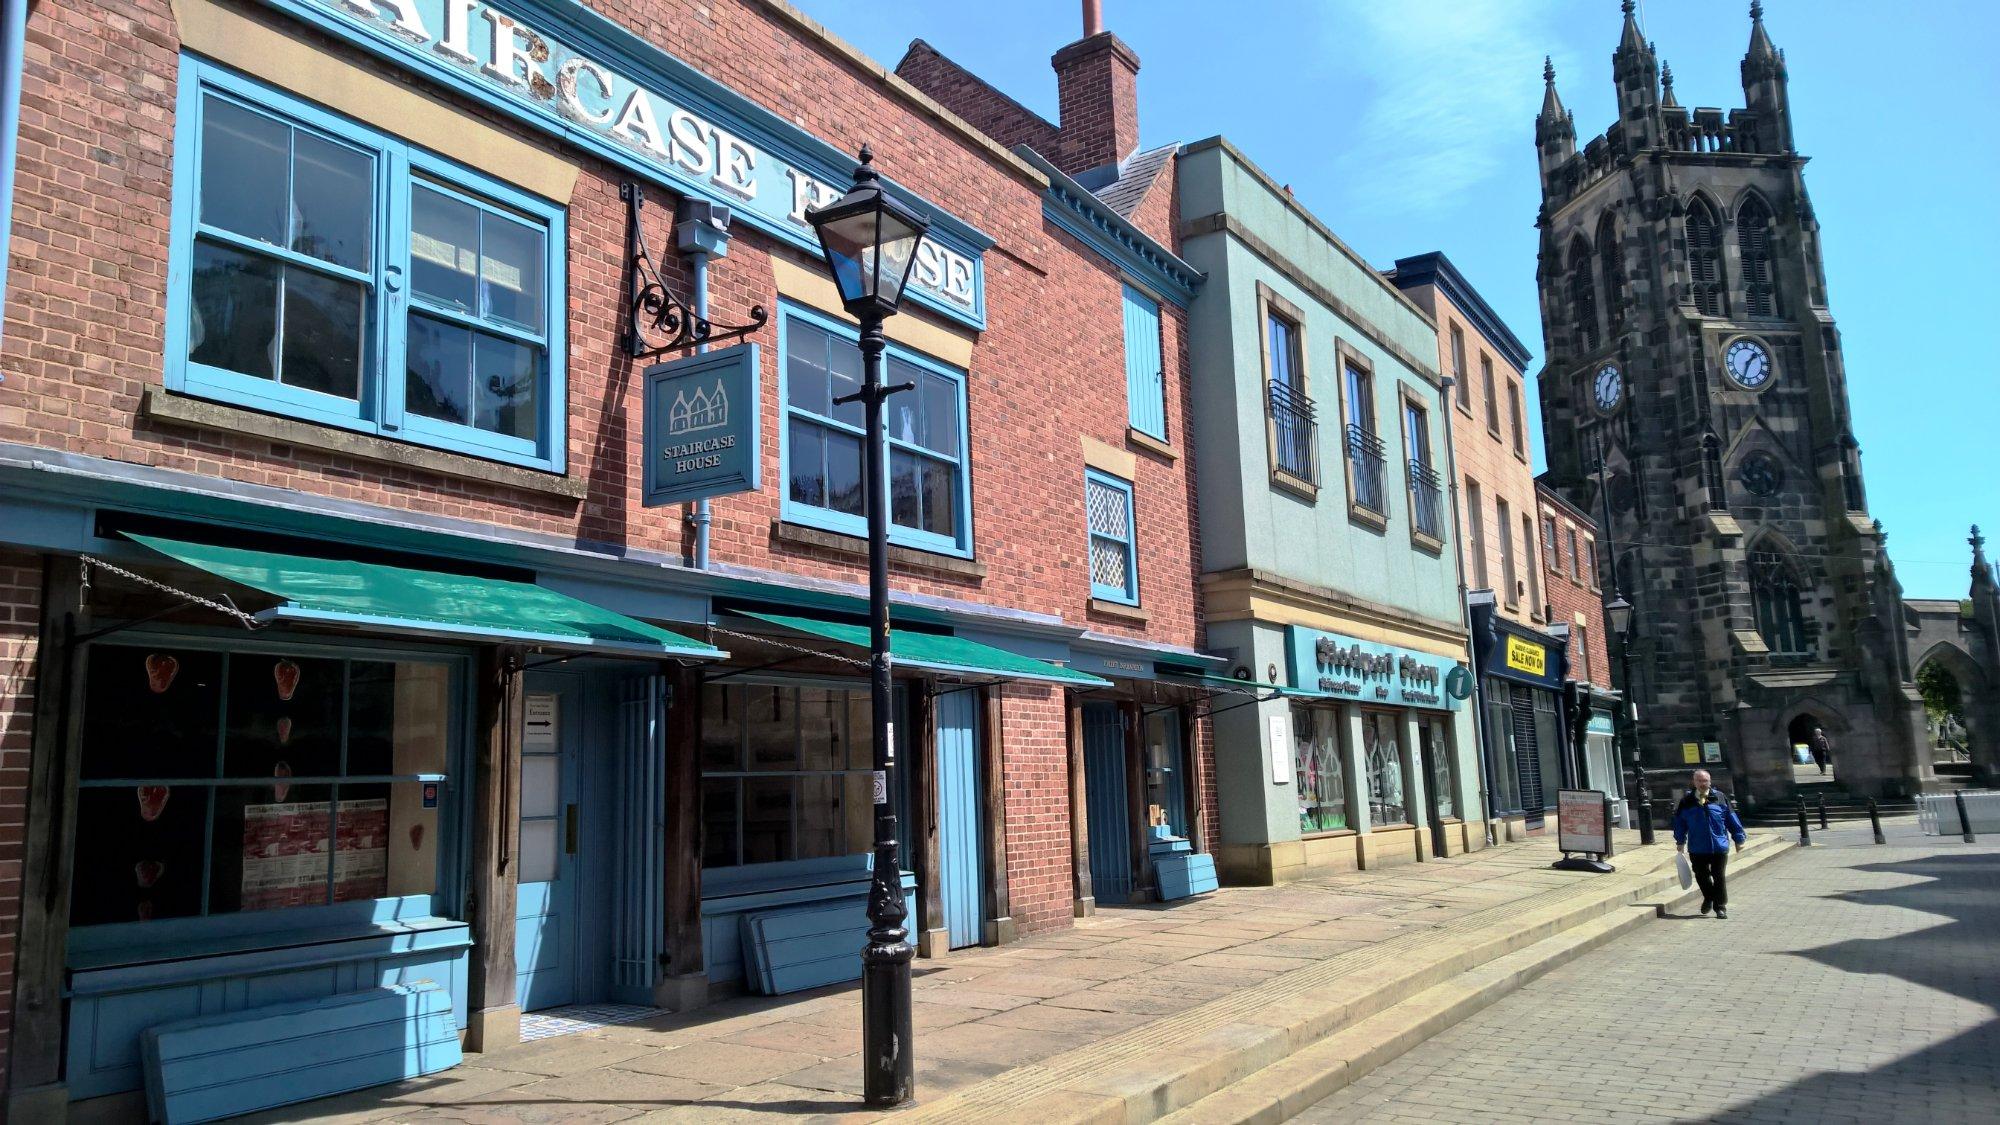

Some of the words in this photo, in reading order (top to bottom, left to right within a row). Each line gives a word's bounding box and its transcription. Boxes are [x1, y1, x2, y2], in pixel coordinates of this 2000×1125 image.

[664, 434, 736, 460] STAIRCASE
[676, 453, 722, 475] HOUSE
[1512, 650, 1524, 664] SALE
[1525, 654, 1536, 667] NOW
